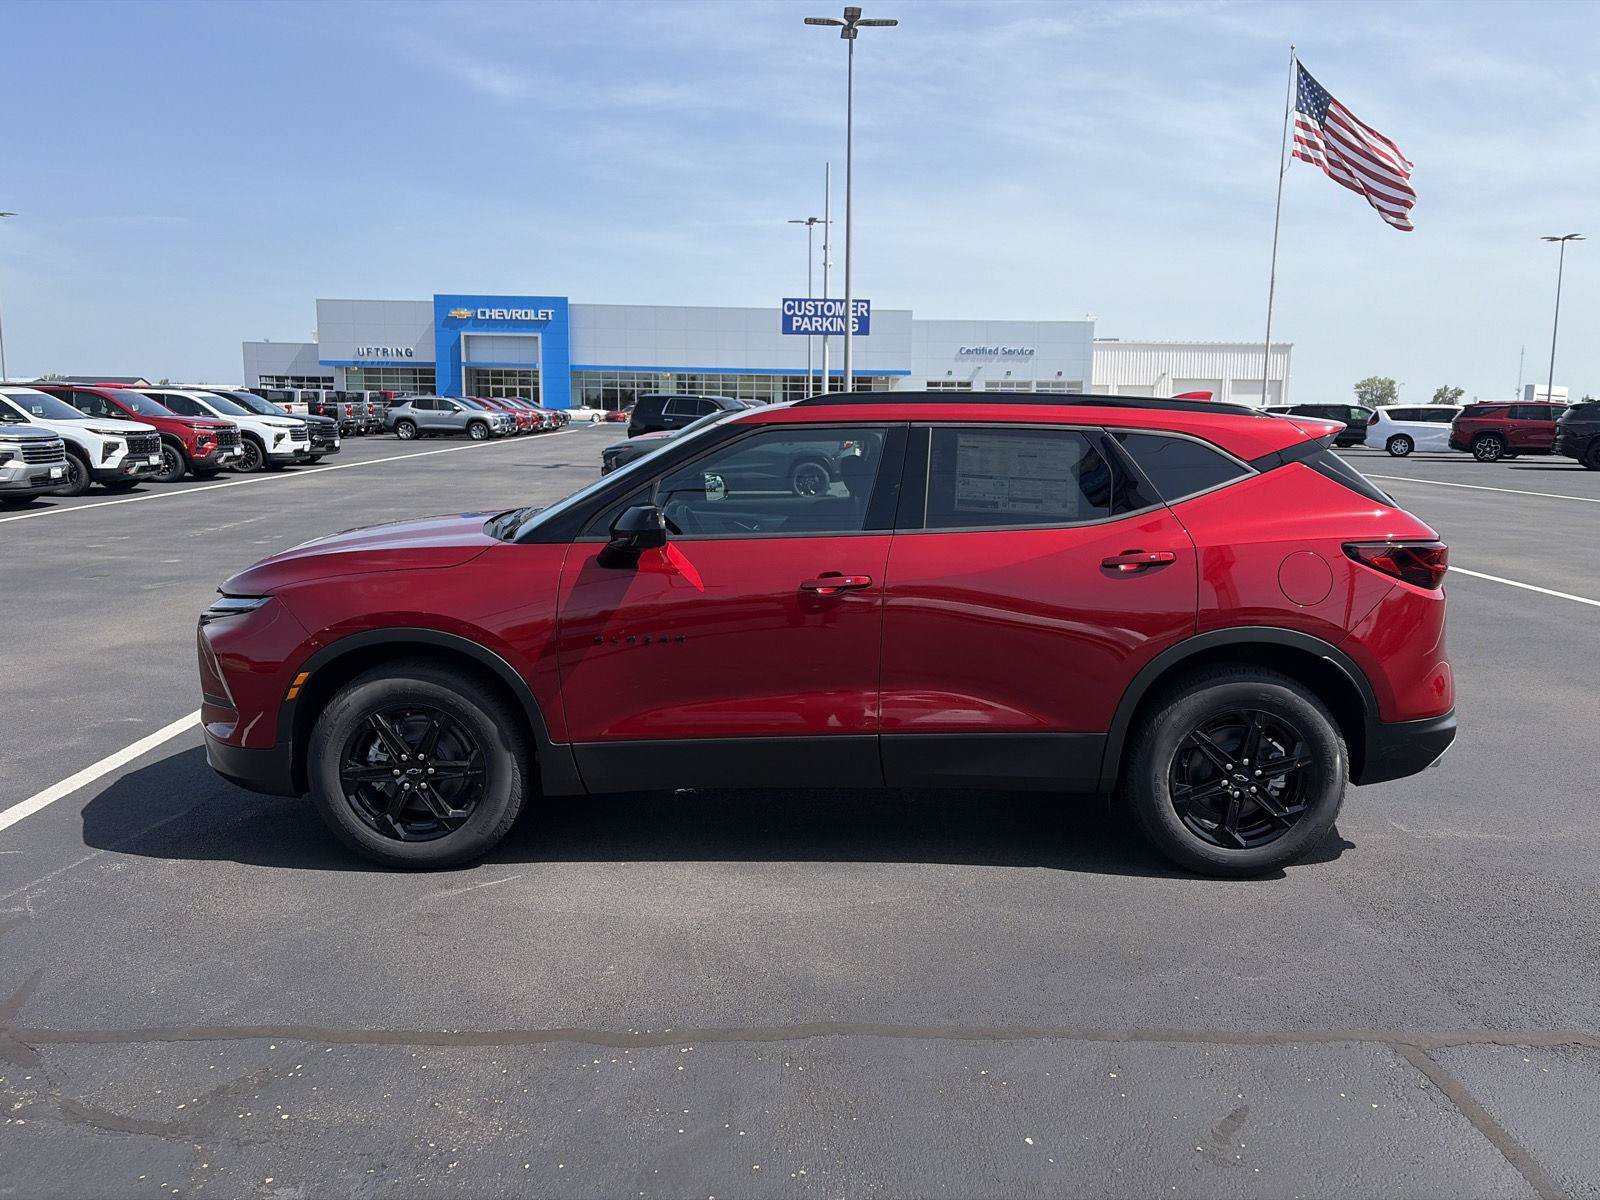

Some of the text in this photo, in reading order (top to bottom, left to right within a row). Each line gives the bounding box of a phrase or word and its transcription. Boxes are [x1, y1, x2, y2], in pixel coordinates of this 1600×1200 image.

[477, 308, 555, 320] CHEVROLET
[783, 300, 869, 317] CUSTOMER
[792, 316, 859, 333] PARKING
[357, 347, 413, 357] UFTRING
[959, 346, 1035, 356] Certified Service
